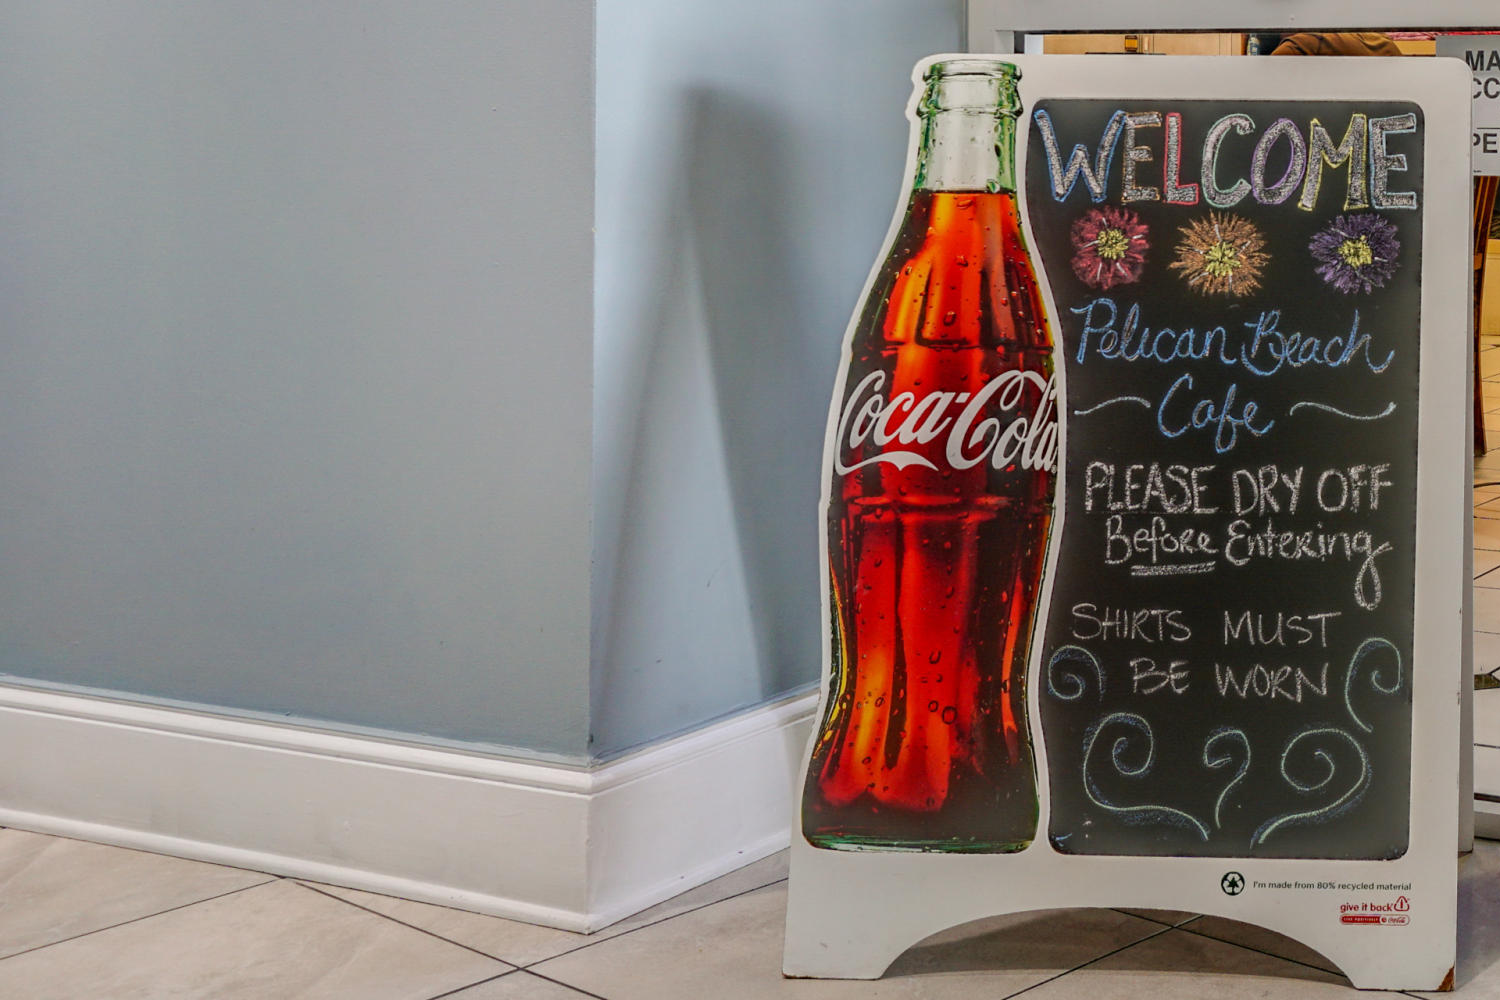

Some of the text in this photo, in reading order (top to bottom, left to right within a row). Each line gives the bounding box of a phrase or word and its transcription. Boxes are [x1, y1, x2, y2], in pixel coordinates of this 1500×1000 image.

[1034, 109, 1417, 211] WELCOME
[1070, 297, 1395, 375] Pelican Beach
[834, 369, 1062, 476] Coca-Cola
[1158, 372, 1275, 454] Cafe
[1085, 461, 1394, 515] PLEASE DRY OFF
[1104, 514, 1394, 610] Before Entering
[1072, 603, 1342, 648] SHIRTS MUST
[1130, 657, 1329, 703] BE WORN
[1253, 880, 1412, 892] I'm made from 80% recycled material
[1340, 902, 1392, 913] give it back
